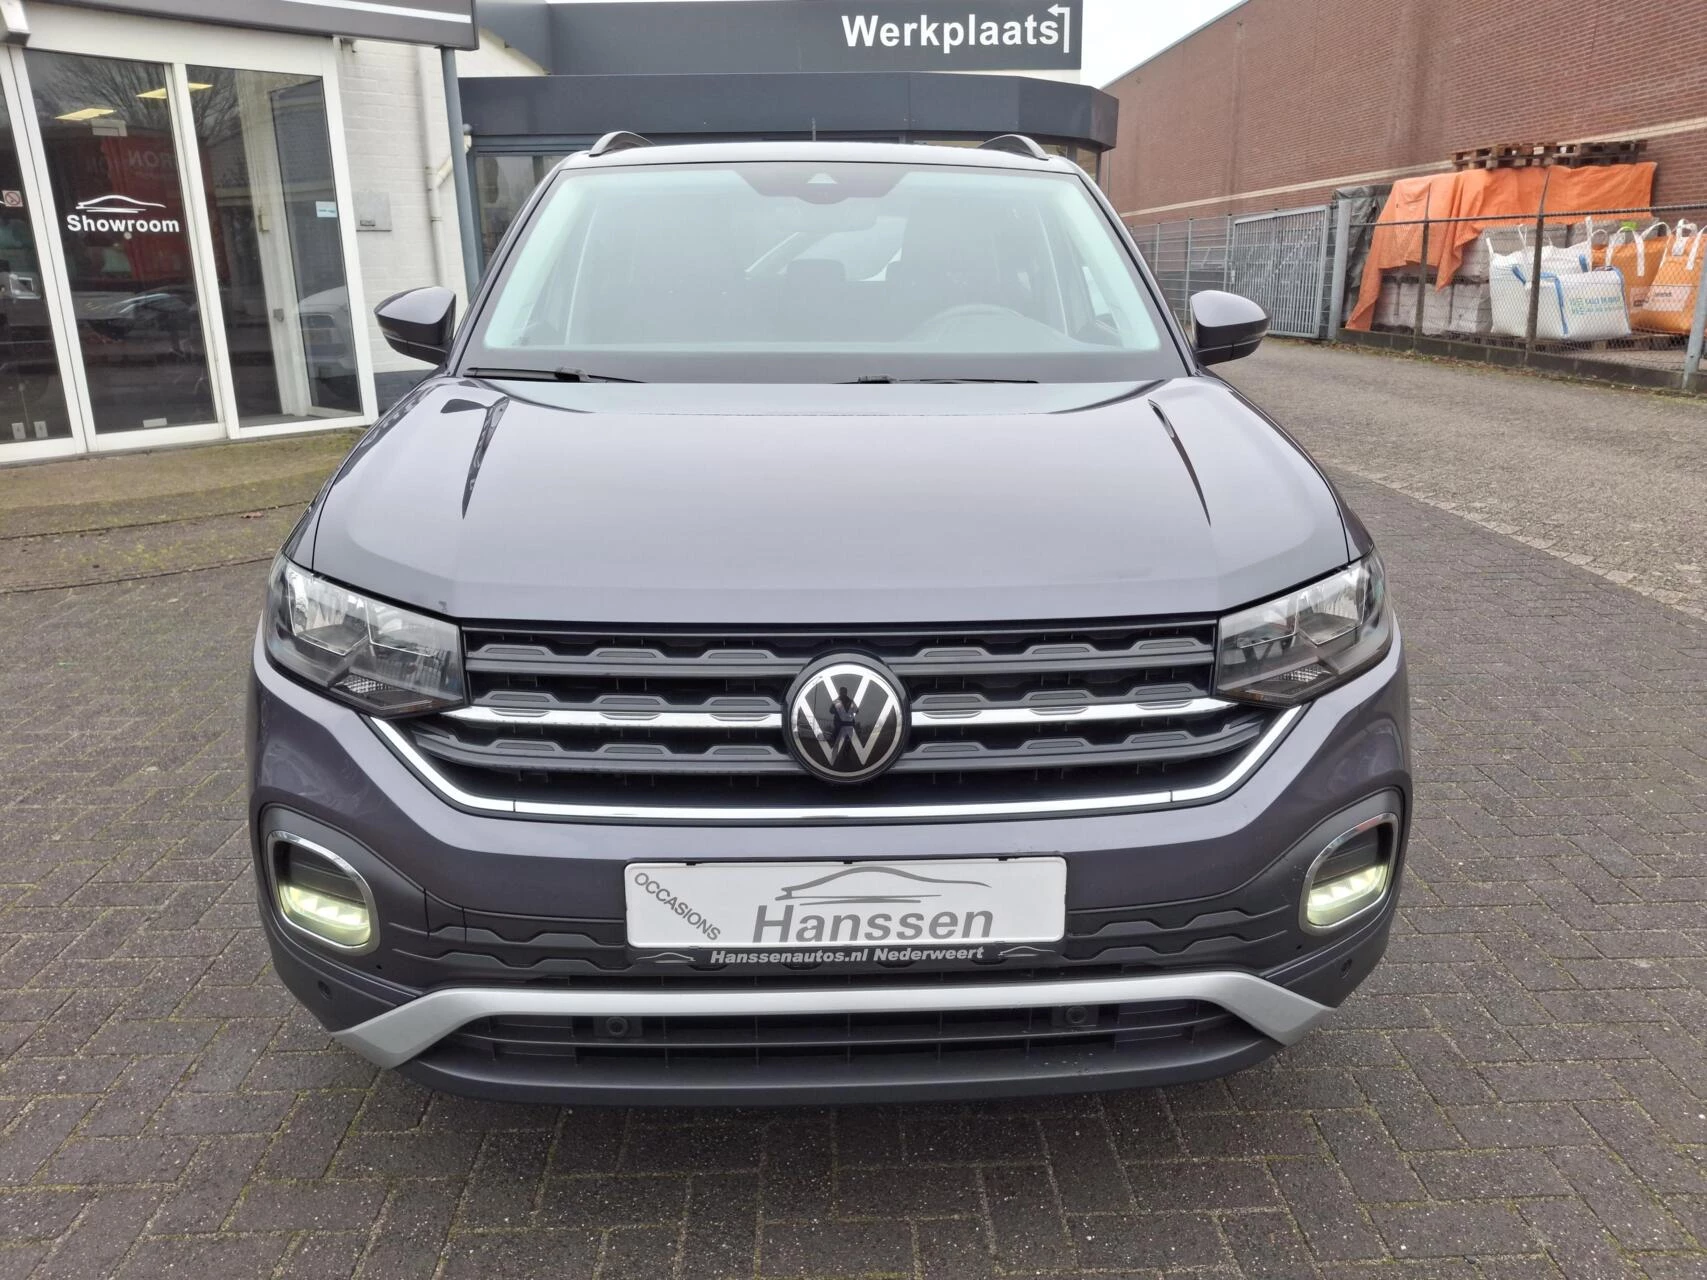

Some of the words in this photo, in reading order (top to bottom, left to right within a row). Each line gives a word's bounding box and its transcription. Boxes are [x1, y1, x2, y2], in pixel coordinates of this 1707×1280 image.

[841, 14, 1059, 54] Werkplaats
[66, 215, 180, 233] Showroom
[634, 872, 721, 941] OCCASIONS
[752, 904, 993, 943] Hanssen
[710, 949, 868, 964] Hanssenautos.nl
[873, 946, 985, 961] Nederweert
